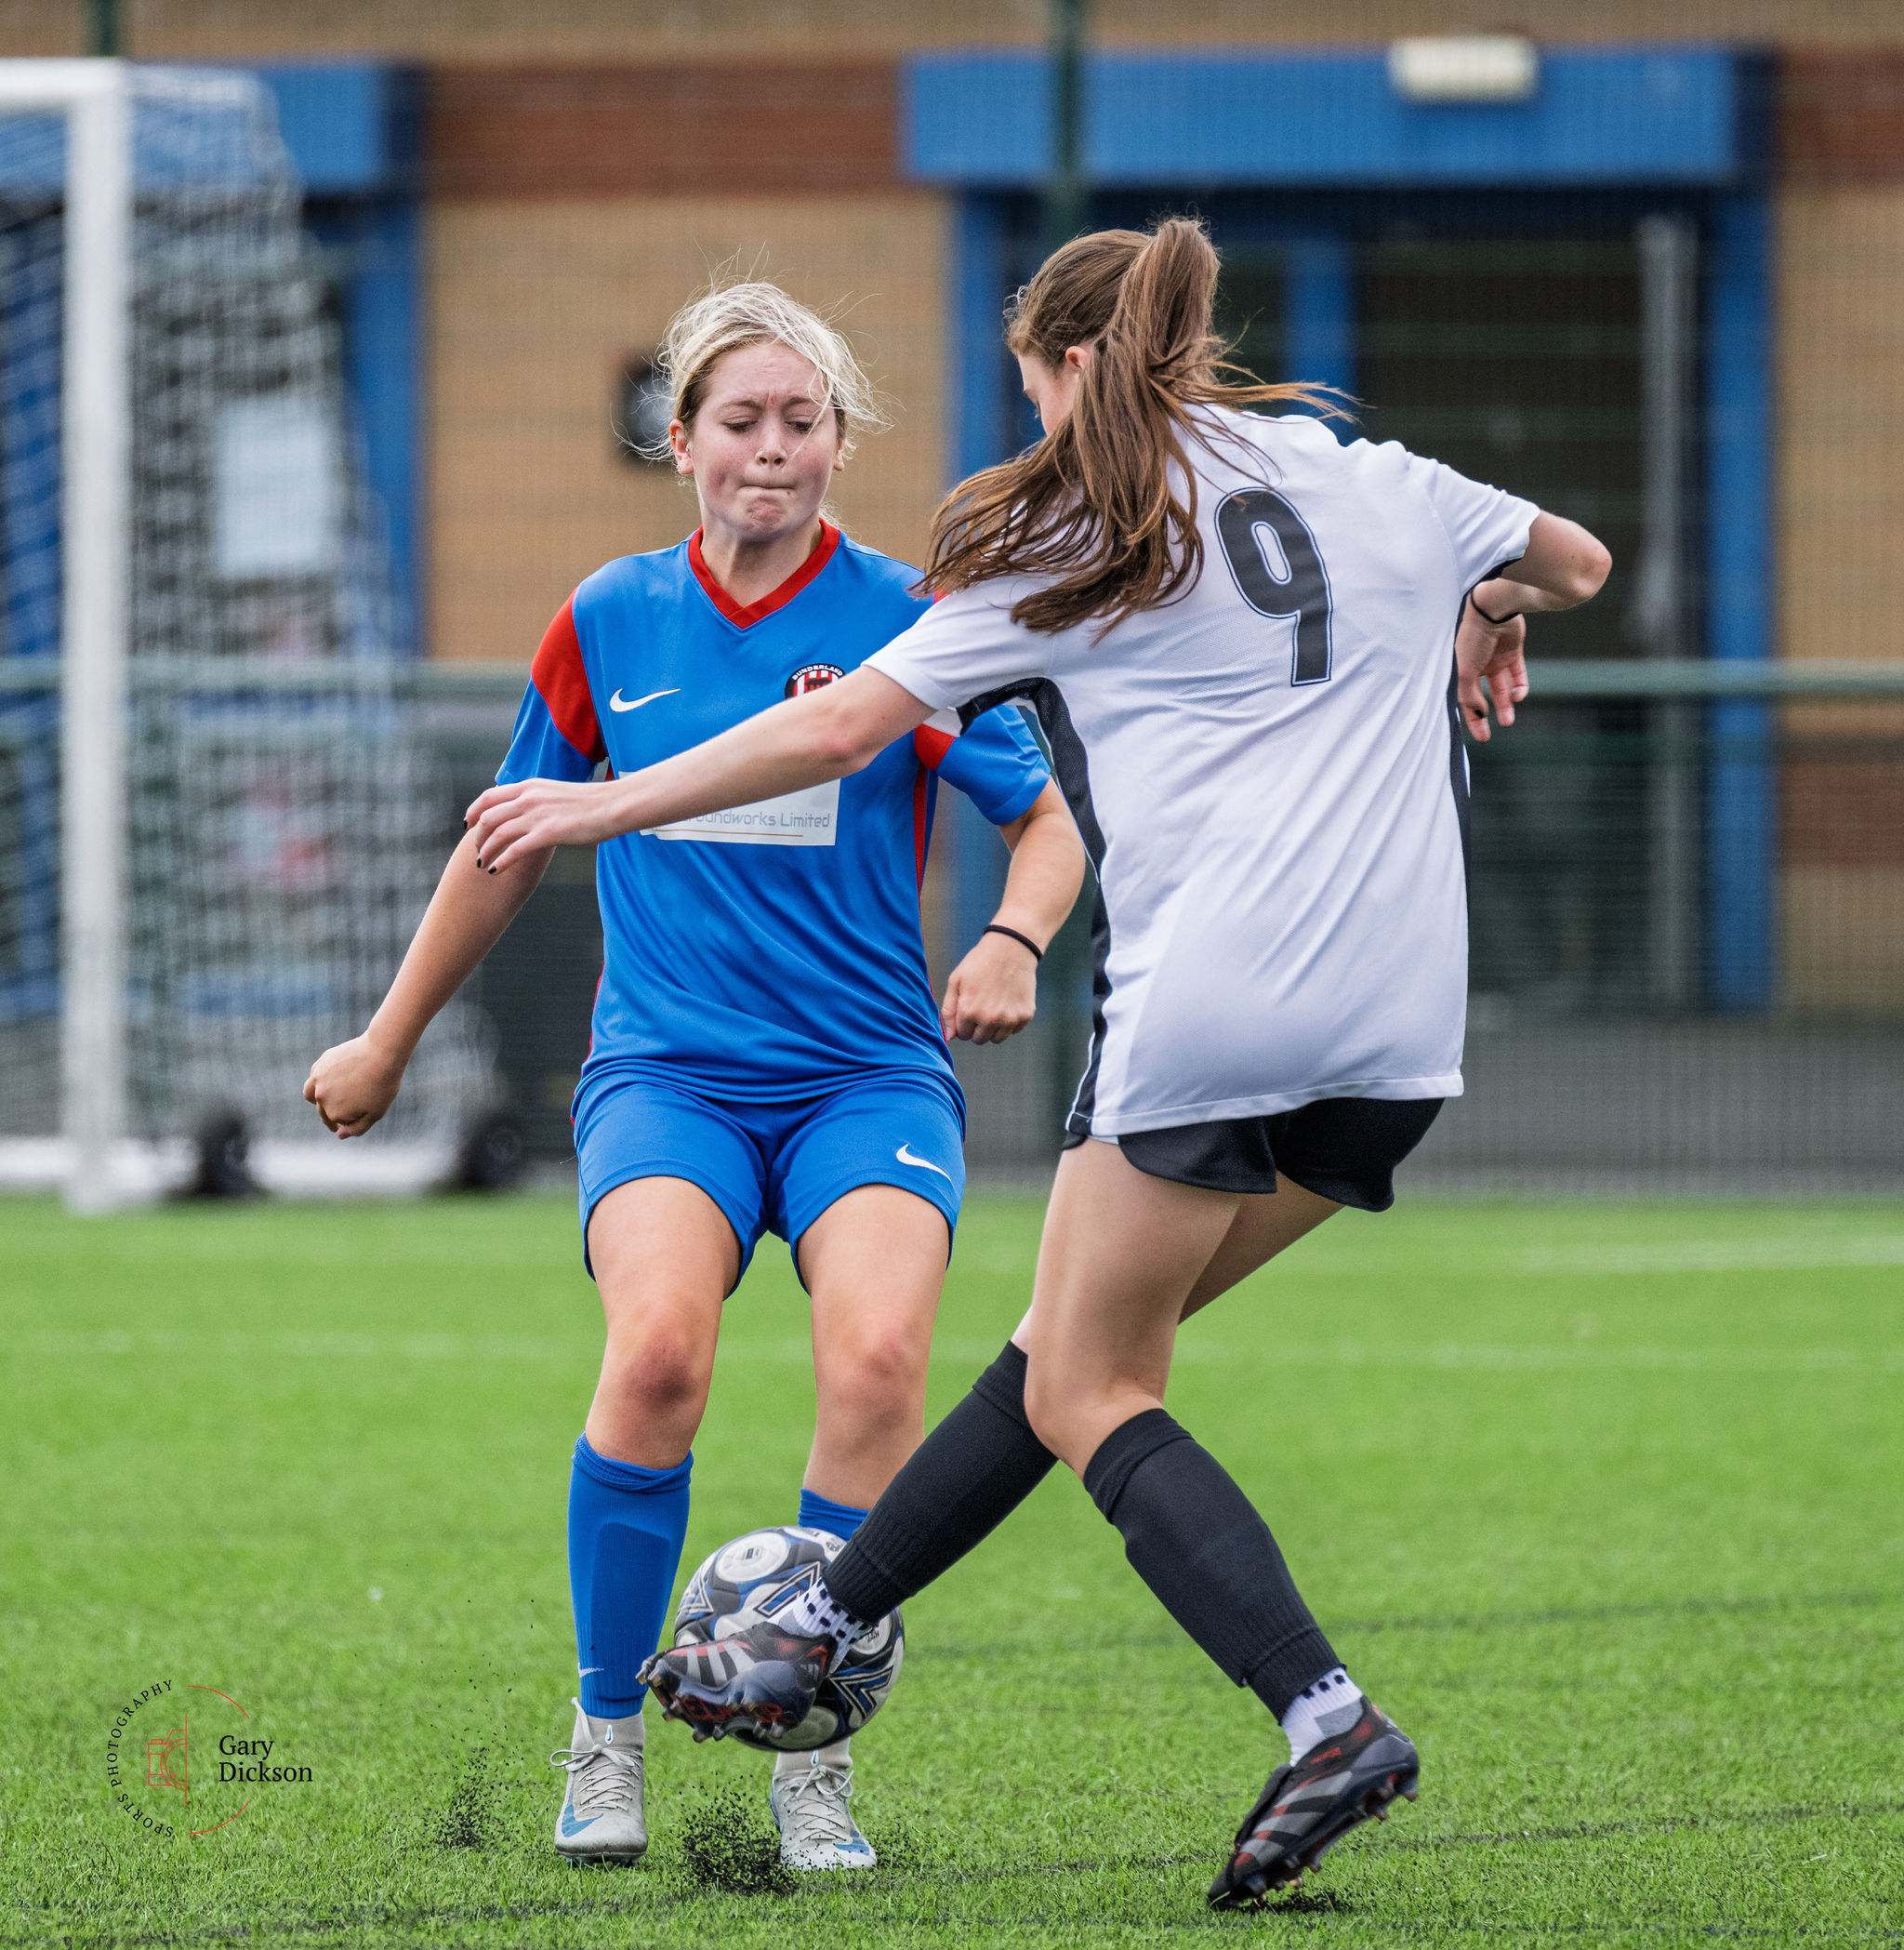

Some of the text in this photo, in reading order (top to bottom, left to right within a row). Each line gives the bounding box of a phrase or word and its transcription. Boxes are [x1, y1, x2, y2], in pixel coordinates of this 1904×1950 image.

[1214, 486, 1333, 687] 9
[791, 664, 843, 681] SUNDERLAND
[688, 810, 831, 828] oundworks Limited
